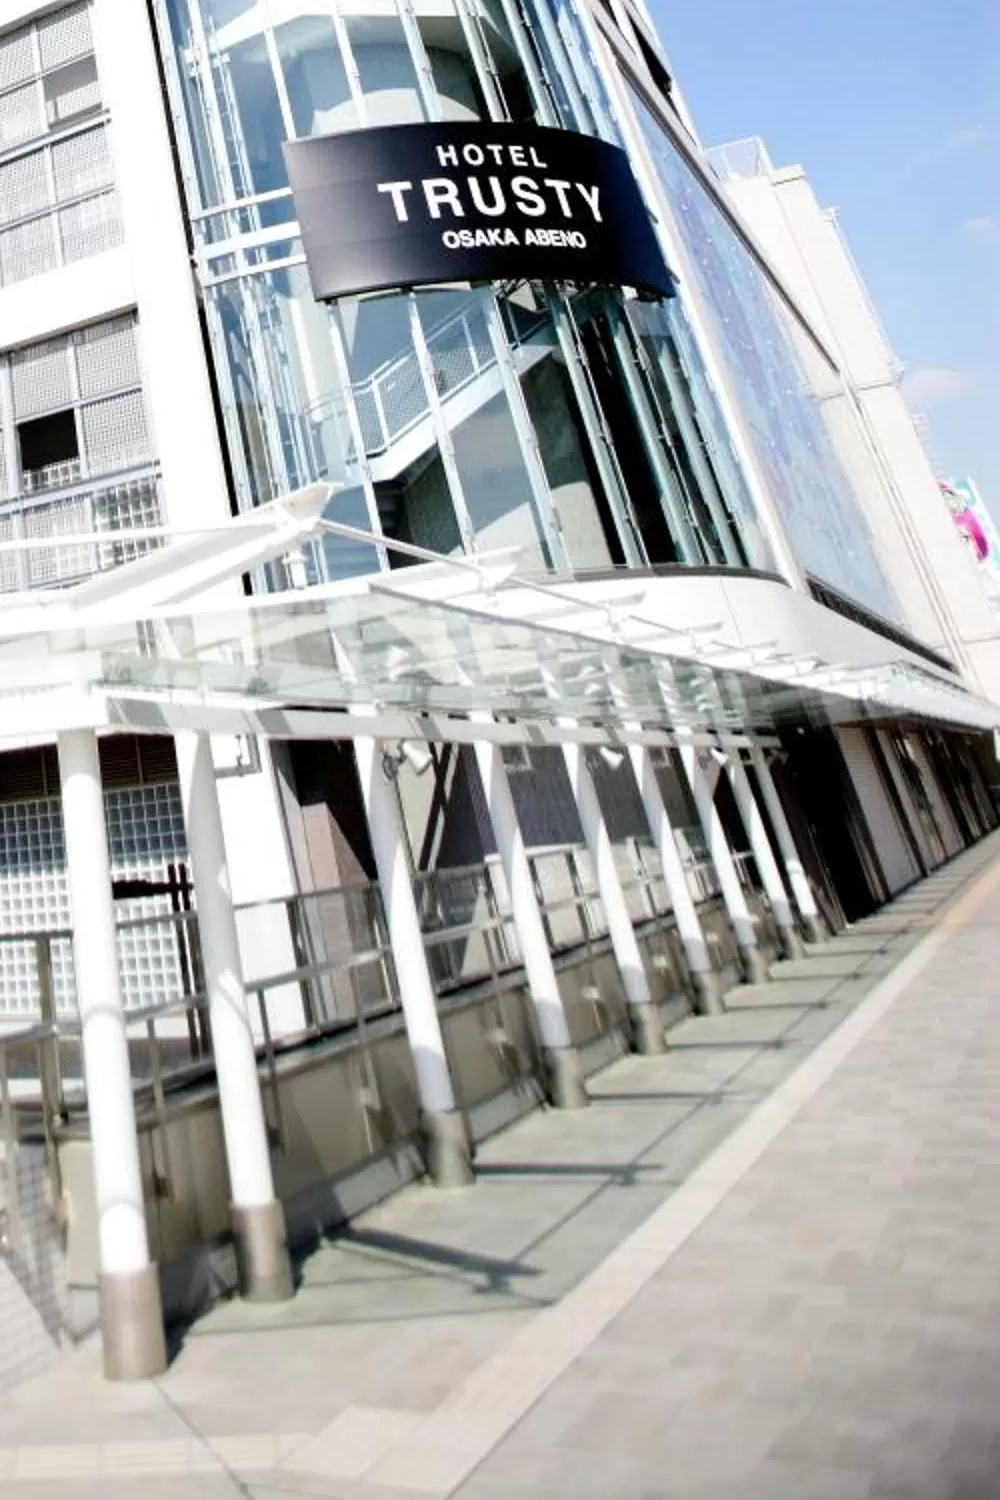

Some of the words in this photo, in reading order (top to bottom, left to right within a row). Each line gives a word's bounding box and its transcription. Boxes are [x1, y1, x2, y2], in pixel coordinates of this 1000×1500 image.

[436, 143, 548, 169] HOTEL
[376, 175, 603, 223] TRUSTY
[441, 228, 520, 249] OSAKA
[524, 228, 587, 249] ABENO
